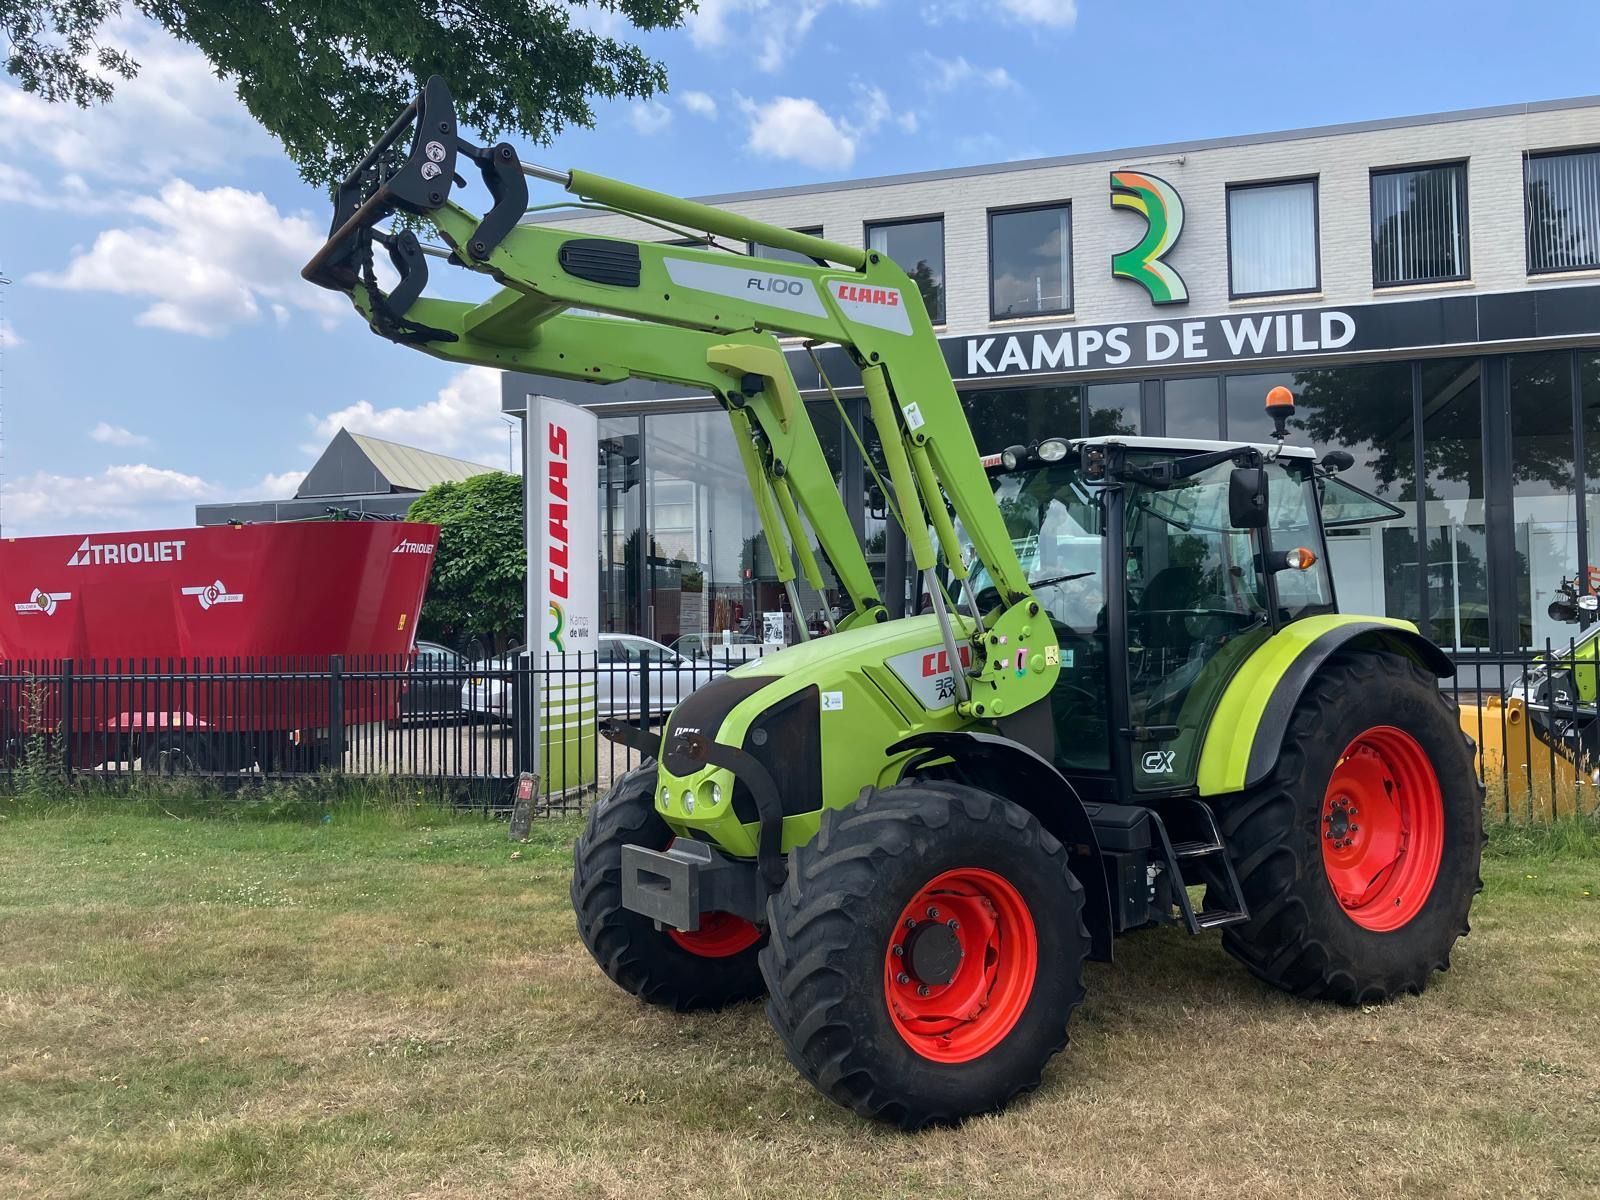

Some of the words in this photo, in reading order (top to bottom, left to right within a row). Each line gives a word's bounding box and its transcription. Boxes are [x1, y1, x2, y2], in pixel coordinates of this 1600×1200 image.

[838, 285, 899, 306] CLAAS
[967, 327, 1131, 375] KAMPS
[1146, 321, 1208, 361] DE
[1219, 311, 1356, 356] WILD
[548, 421, 569, 600] CLAAS
[90, 540, 186, 565] TRIOLIET
[569, 628, 578, 638] de
[578, 627, 589, 638] Wild
[1141, 750, 1176, 773] CX
